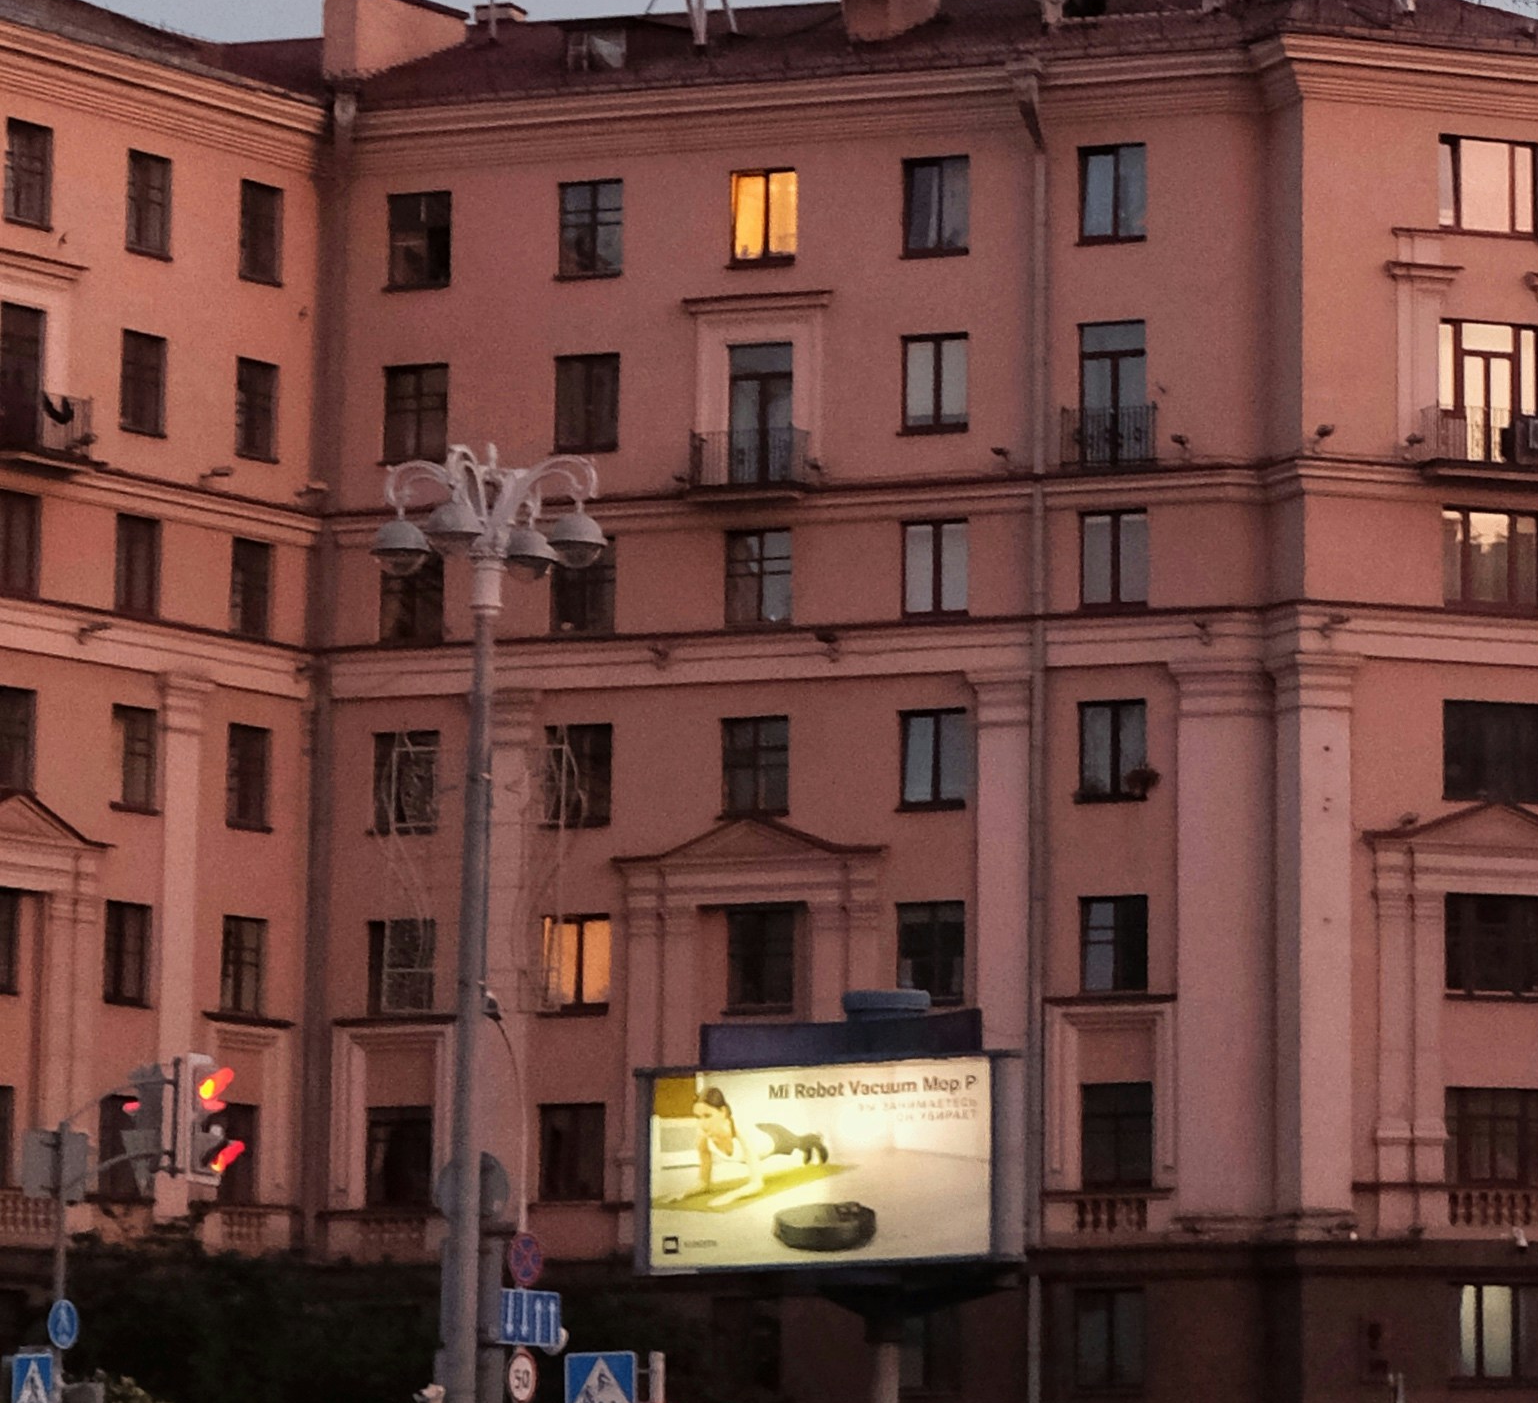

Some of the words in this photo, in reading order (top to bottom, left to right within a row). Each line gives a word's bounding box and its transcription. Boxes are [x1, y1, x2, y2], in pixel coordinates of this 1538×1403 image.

[768, 1084, 789, 1099] Mi
[794, 1082, 844, 1098] Robot
[848, 1080, 917, 1096] Vacuum
[923, 1076, 959, 1095] Mop
[965, 1075, 977, 1089] P
